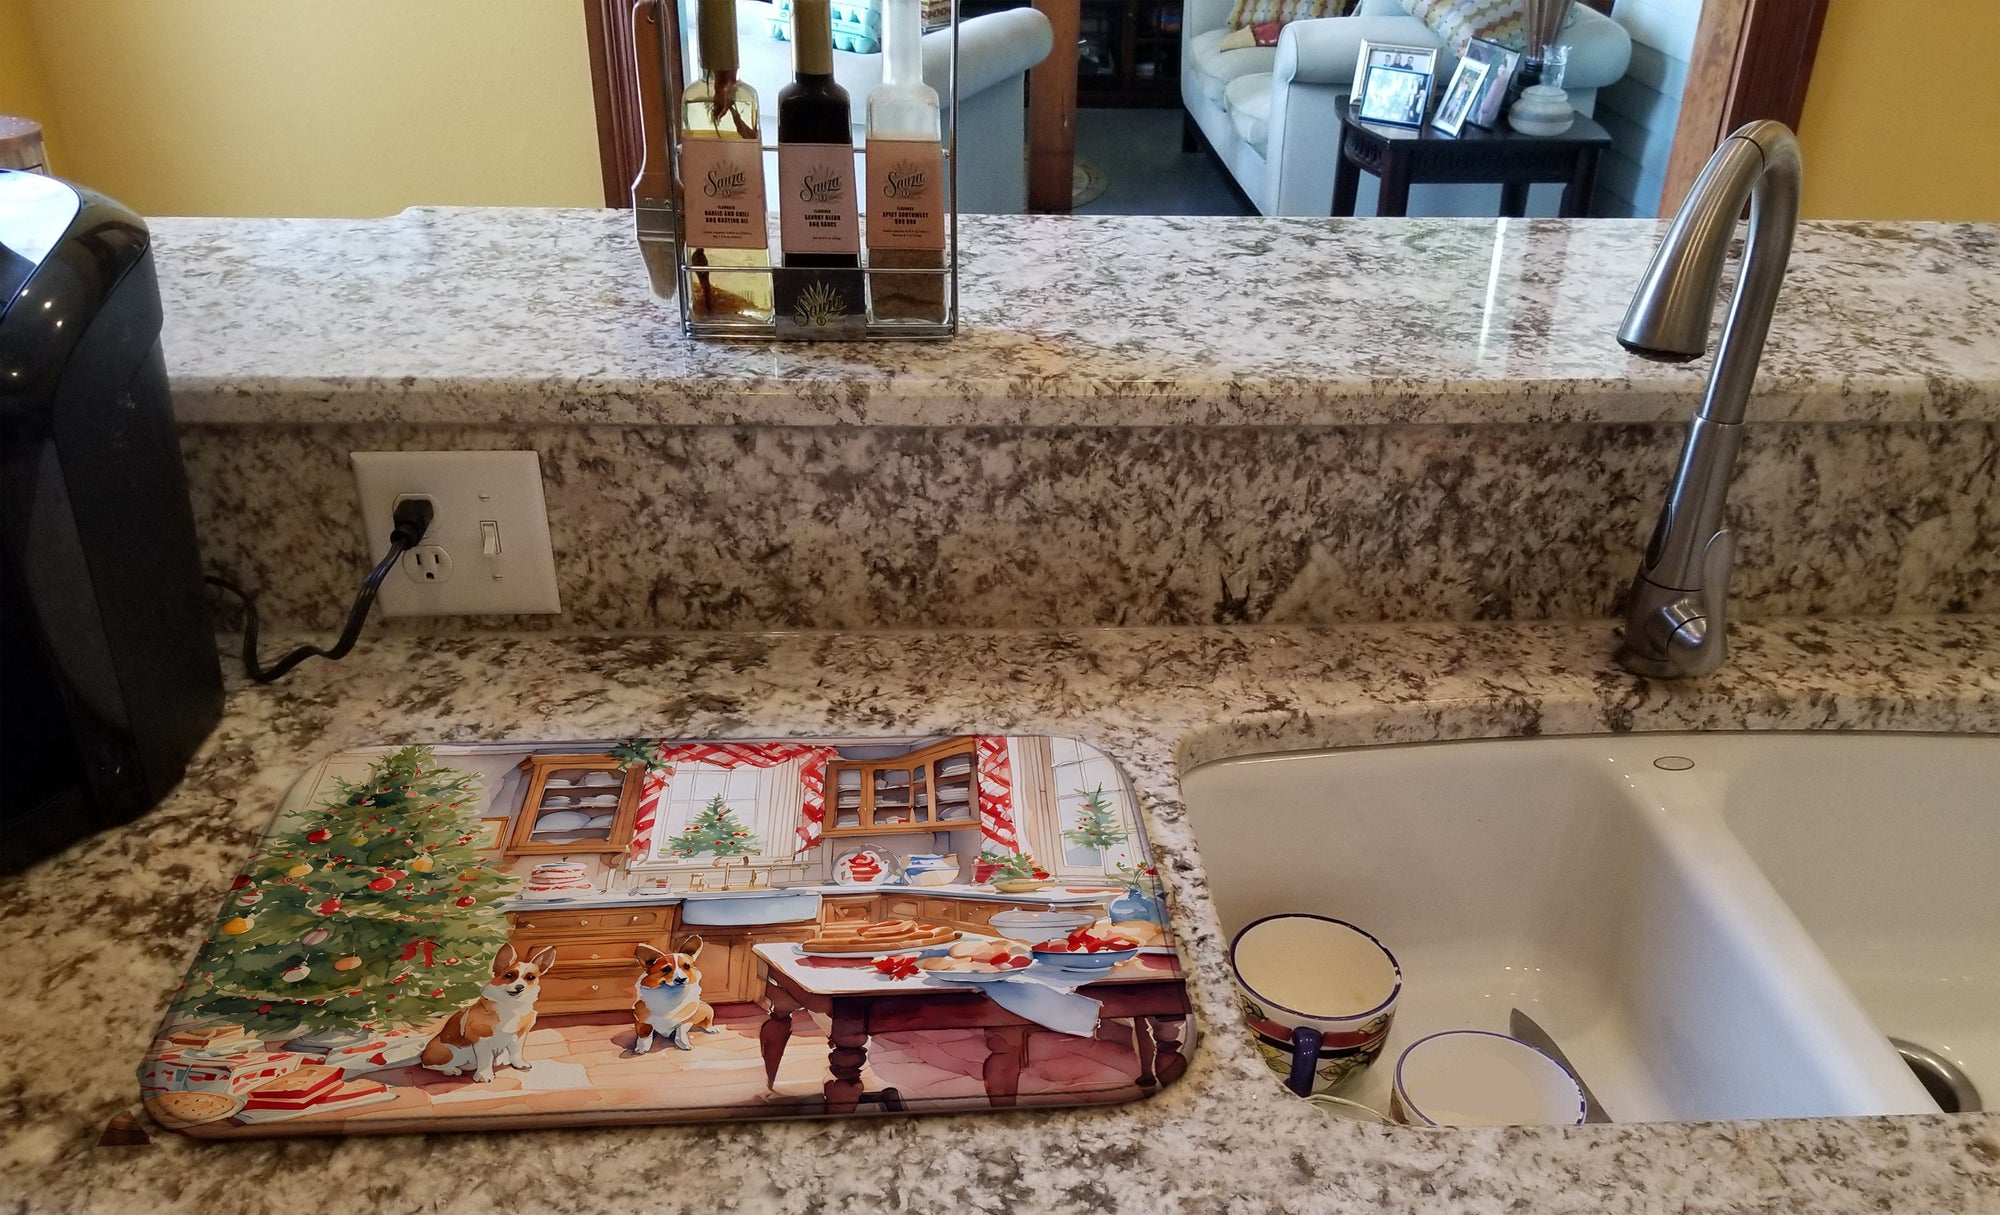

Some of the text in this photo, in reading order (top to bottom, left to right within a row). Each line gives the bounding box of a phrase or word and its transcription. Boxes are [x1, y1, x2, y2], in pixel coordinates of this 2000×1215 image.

[703, 170, 746, 197] Sauza
[800, 175, 842, 202] Sauza
[883, 170, 925, 198] Sauza
